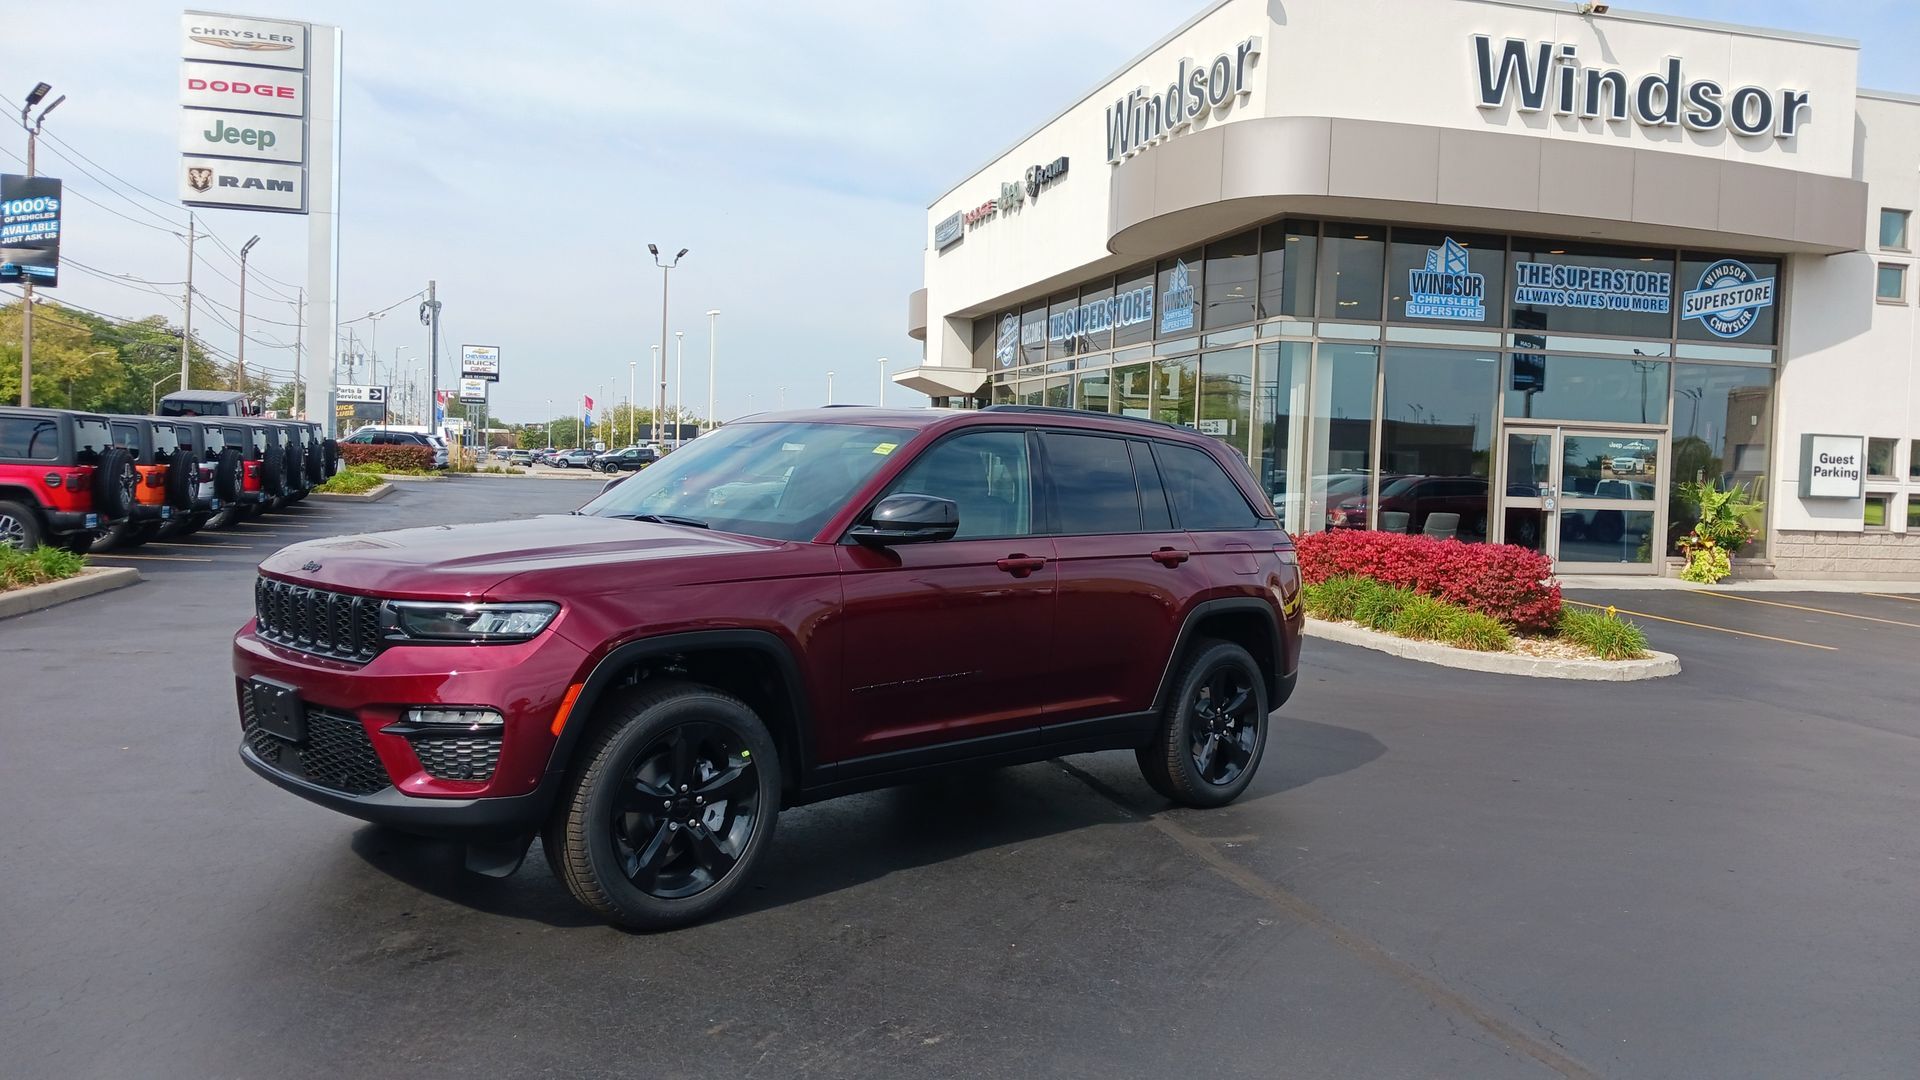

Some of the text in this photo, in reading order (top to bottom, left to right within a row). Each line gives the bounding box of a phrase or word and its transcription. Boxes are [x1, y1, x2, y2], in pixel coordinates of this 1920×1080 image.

[190, 26, 294, 43] CHRYSLER
[188, 79, 295, 99] DODGE
[1469, 33, 1810, 138] Windsor
[1105, 35, 1262, 165] Windsor
[204, 120, 276, 151] Jeep
[218, 175, 294, 192] RAM
[2, 198, 59, 215] 1000's
[16, 212, 55, 221] VEHICLES
[2, 222, 58, 236] AVAILABLE
[2, 236, 23, 244] JUST
[25, 233, 43, 241] ASK
[1412, 272, 1482, 297] WINDSOR
[1518, 264, 1670, 294] THE SUPERSTORE
[1704, 265, 1747, 286] WINDSOR
[1417, 295, 1475, 306] CHRYSLER
[1517, 289, 1668, 311] ALWAYS SAVES YOU MORE!
[1686, 286, 1770, 313] SUPERSTORE
[1049, 314, 1064, 340] THE
[1065, 288, 1152, 338] SUPERSTORE
[1409, 305, 1483, 317] SUPERSTORE
[1710, 310, 1752, 332] CHRYSLER
[1819, 452, 1855, 465] Guest
[1813, 466, 1859, 481] Parking
